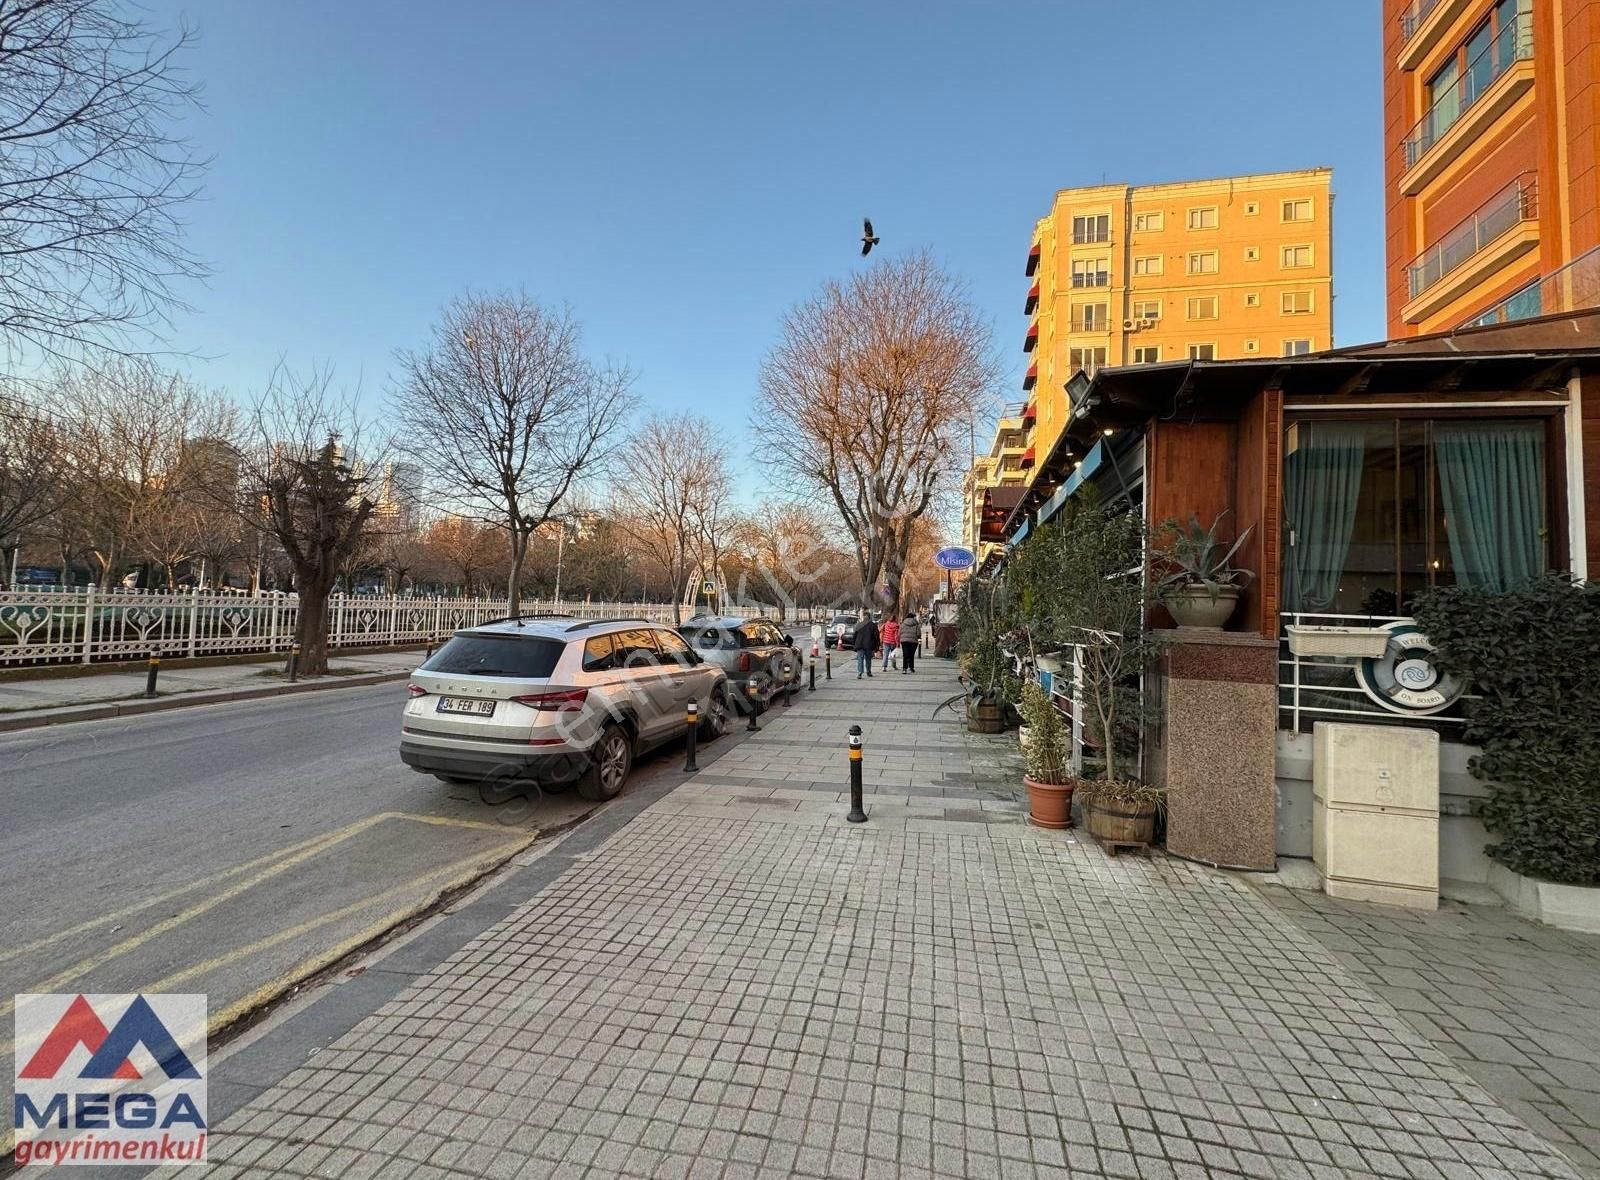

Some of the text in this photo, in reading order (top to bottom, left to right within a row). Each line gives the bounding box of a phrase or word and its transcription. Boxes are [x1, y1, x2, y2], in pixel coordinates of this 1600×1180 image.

[1401, 693, 1441, 704] ON BOARD
[443, 699, 493, 713] 34 FER 189
